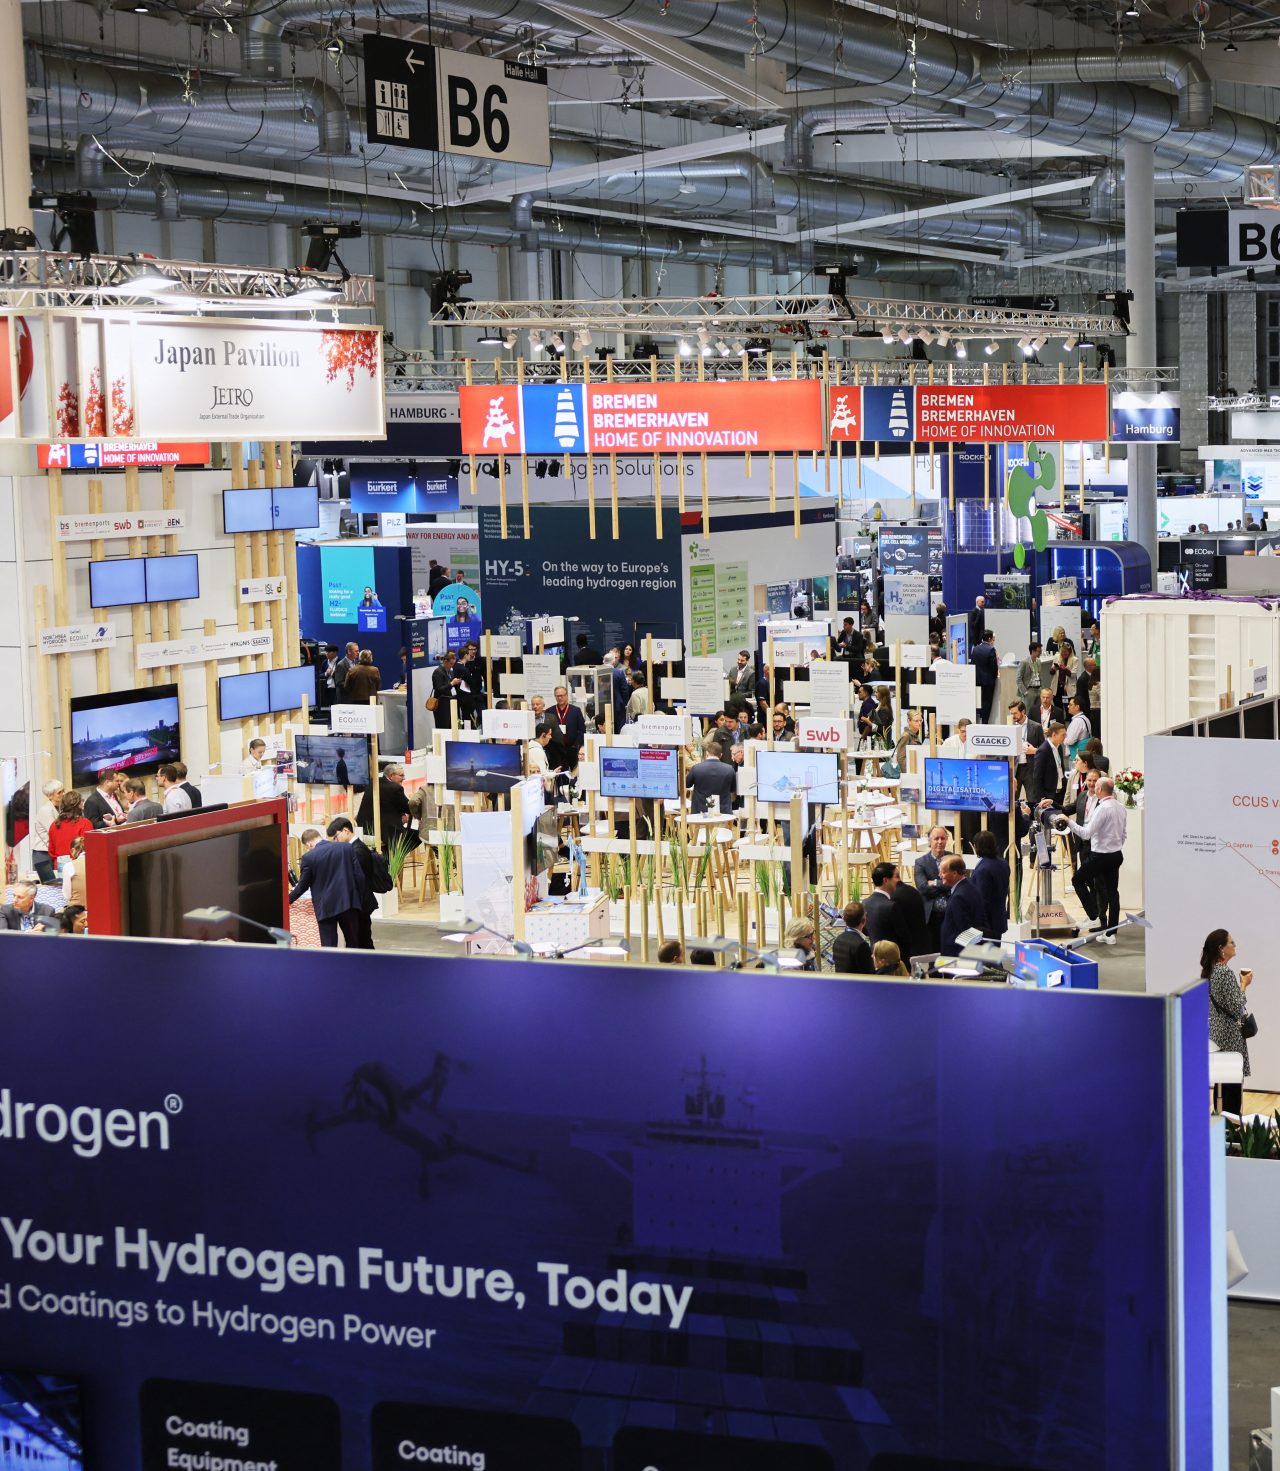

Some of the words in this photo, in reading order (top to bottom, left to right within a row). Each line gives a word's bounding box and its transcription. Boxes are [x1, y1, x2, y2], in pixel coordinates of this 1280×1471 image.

[506, 63, 524, 78] Halle
[448, 74, 510, 153] B6
[154, 338, 216, 372] Japan
[222, 340, 300, 368] Pavilion
[210, 385, 254, 410] JETRO
[592, 394, 658, 410] BREMEN
[921, 394, 974, 408] BREMEN
[390, 407, 448, 420] HAMBURG
[593, 412, 708, 429] BREMERHAVEN
[921, 409, 1016, 422] BREMERHAVEN
[921, 424, 957, 438] HOME
[960, 424, 976, 438] OF
[980, 424, 1056, 438] INNOVATION
[1125, 423, 1174, 437] Hamburg
[594, 432, 638, 448] HOME
[642, 432, 662, 447] OF
[666, 430, 758, 447] INNOVATION
[104, 453, 124, 463] HOME
[126, 453, 136, 463] OF
[137, 452, 180, 463] INNOVATION
[526, 460, 608, 479] Hrogen
[616, 459, 694, 476] Soluions
[114, 520, 132, 530] swb
[485, 560, 524, 576] HY-5
[542, 561, 558, 572] On
[562, 561, 575, 573] the
[578, 564, 600, 576] way
[604, 562, 616, 574] to
[621, 562, 668, 576] Europe's
[542, 576, 582, 590] leading
[586, 576, 632, 590] hydrogen
[636, 578, 676, 590] region
[806, 726, 840, 742] swb
[928, 786, 986, 794] DIGITALISATION
[1232, 795, 1269, 808] CCUS
[0, 1216, 104, 1265] Your
[114, 1226, 345, 1292] Hydrogen
[358, 1247, 526, 1310] Future,
[537, 1262, 694, 1329] Today
[18, 1284, 148, 1327] Coatings
[155, 1300, 186, 1326] to
[192, 1300, 335, 1343] Hydrogen
[344, 1314, 436, 1348] Power
[166, 1416, 250, 1446] Coating
[399, 1440, 486, 1471] Coating
